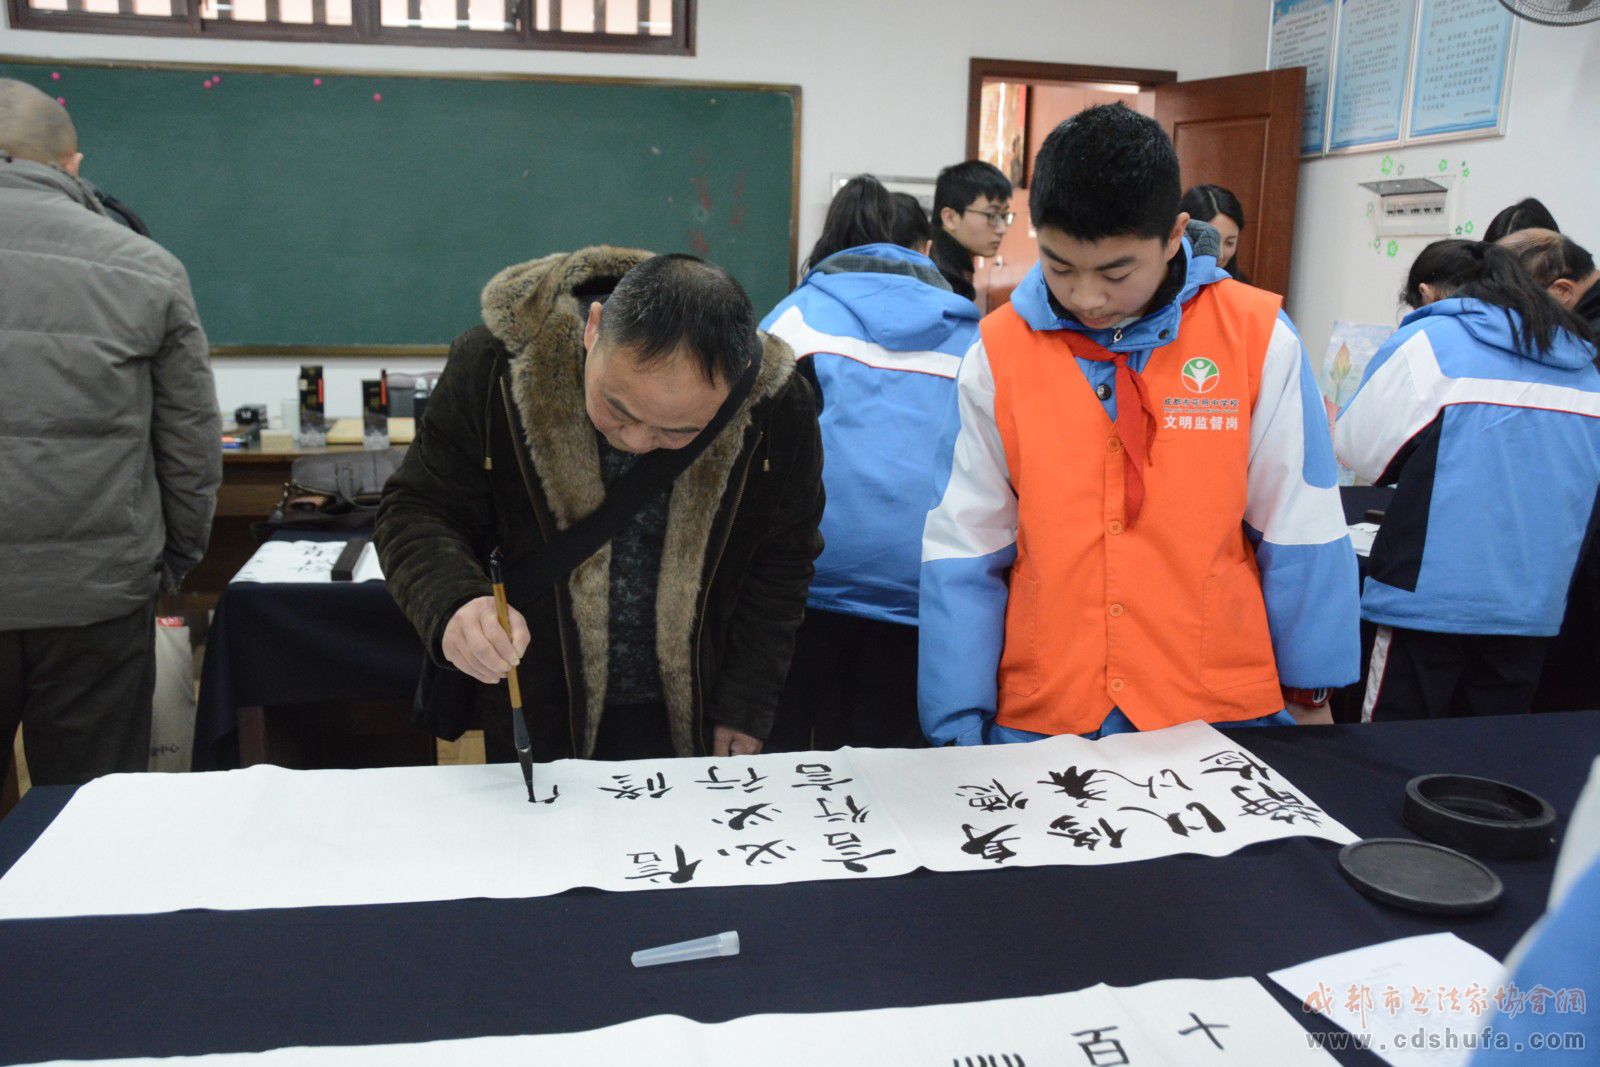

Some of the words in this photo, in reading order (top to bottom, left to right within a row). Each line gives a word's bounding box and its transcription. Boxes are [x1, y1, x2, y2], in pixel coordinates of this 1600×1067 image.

[1163, 415, 1239, 430] 文明监督岗
